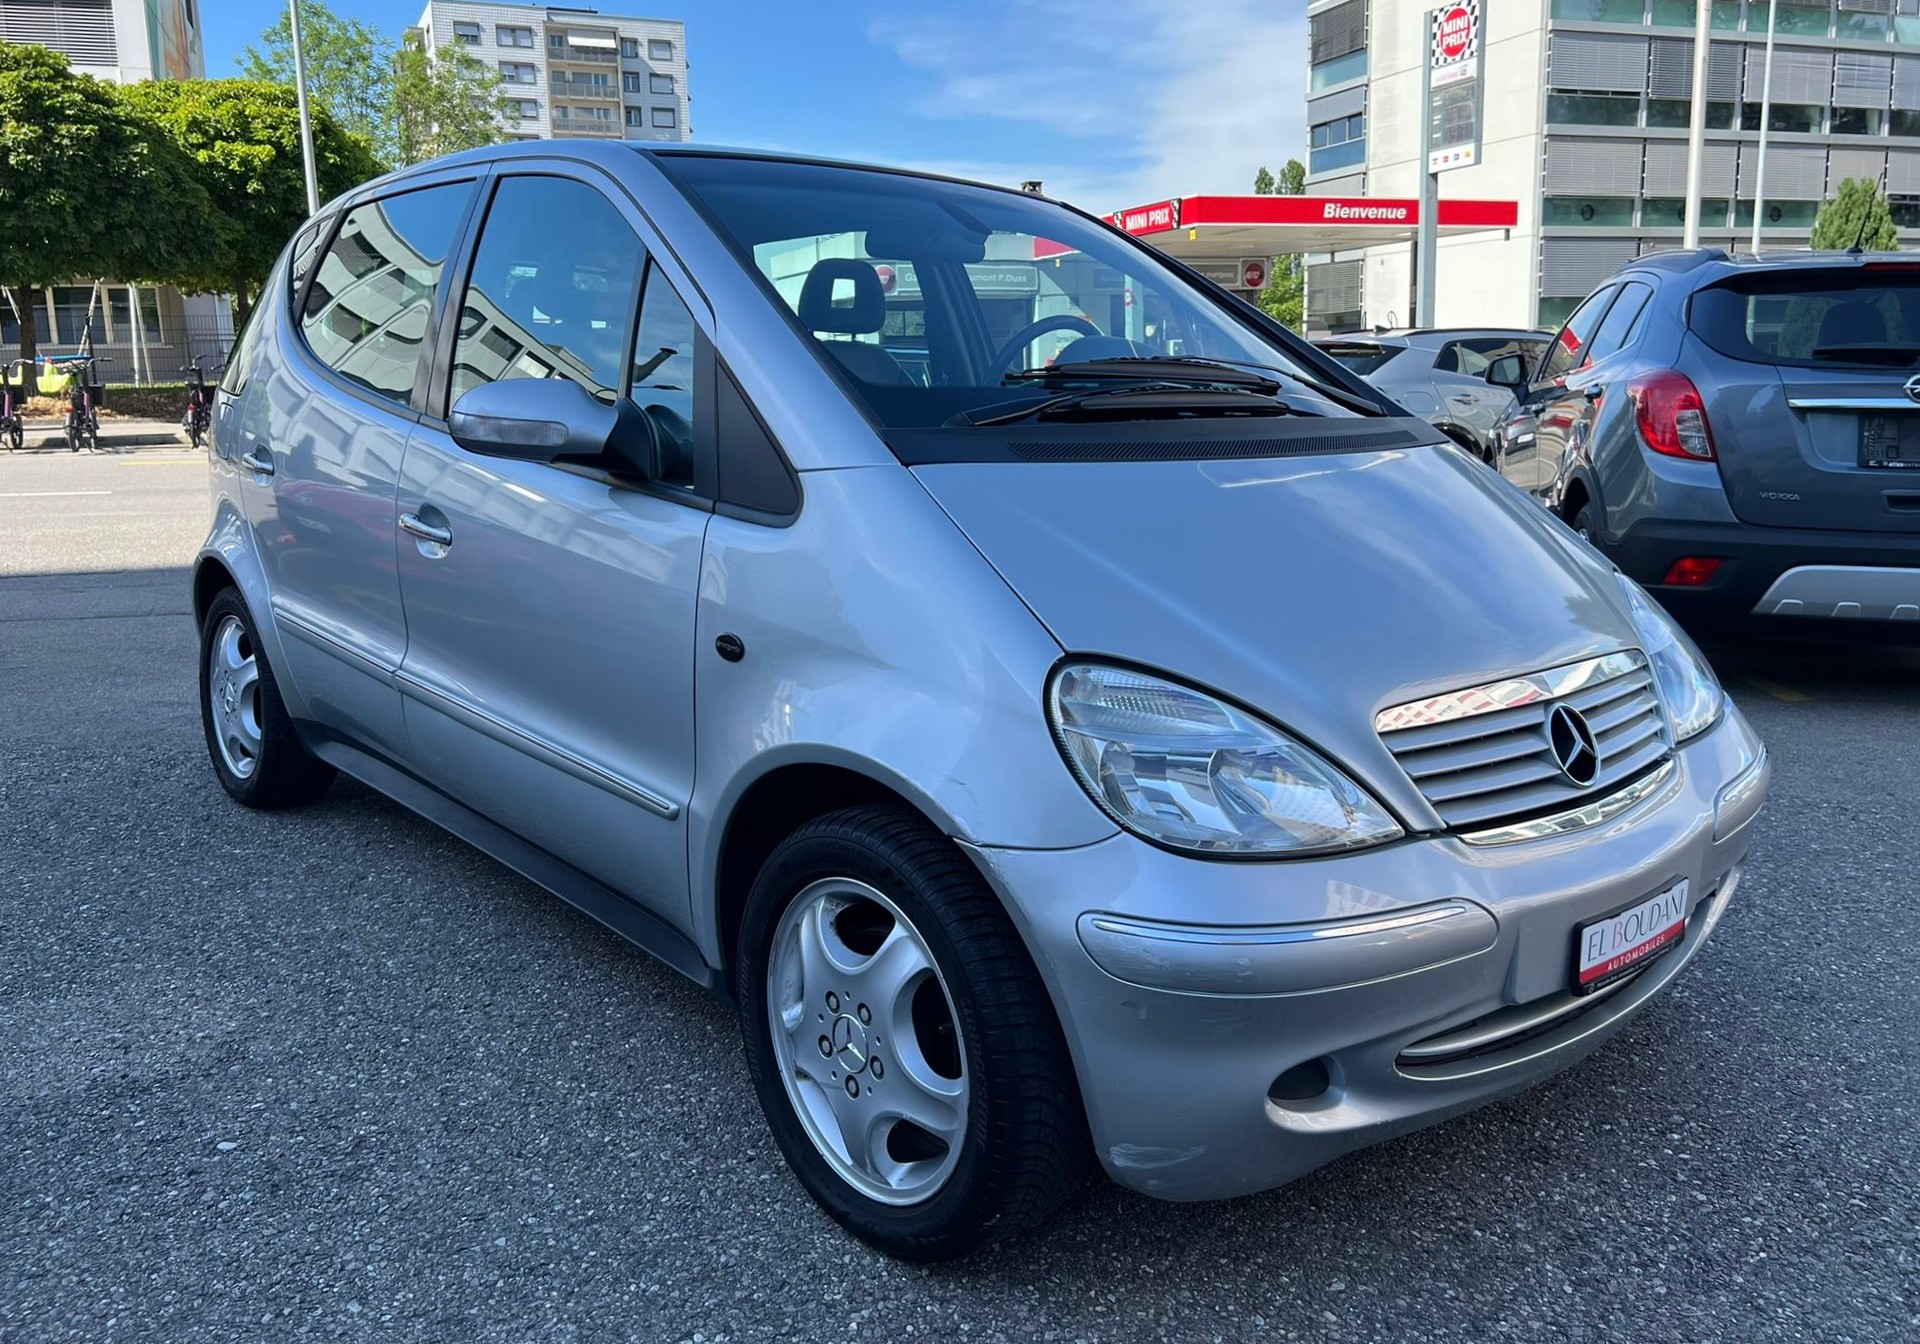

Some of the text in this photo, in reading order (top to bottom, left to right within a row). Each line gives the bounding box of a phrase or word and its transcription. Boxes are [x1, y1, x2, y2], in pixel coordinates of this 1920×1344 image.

[1442, 14, 1469, 35] MINI
[1442, 29, 1469, 50] PRIX
[1125, 207, 1170, 231] MINI PRIX
[1323, 203, 1406, 219] Bienvenue
[1588, 928, 1607, 962] EL
[1607, 934, 1665, 972] AUTOMOBILES
